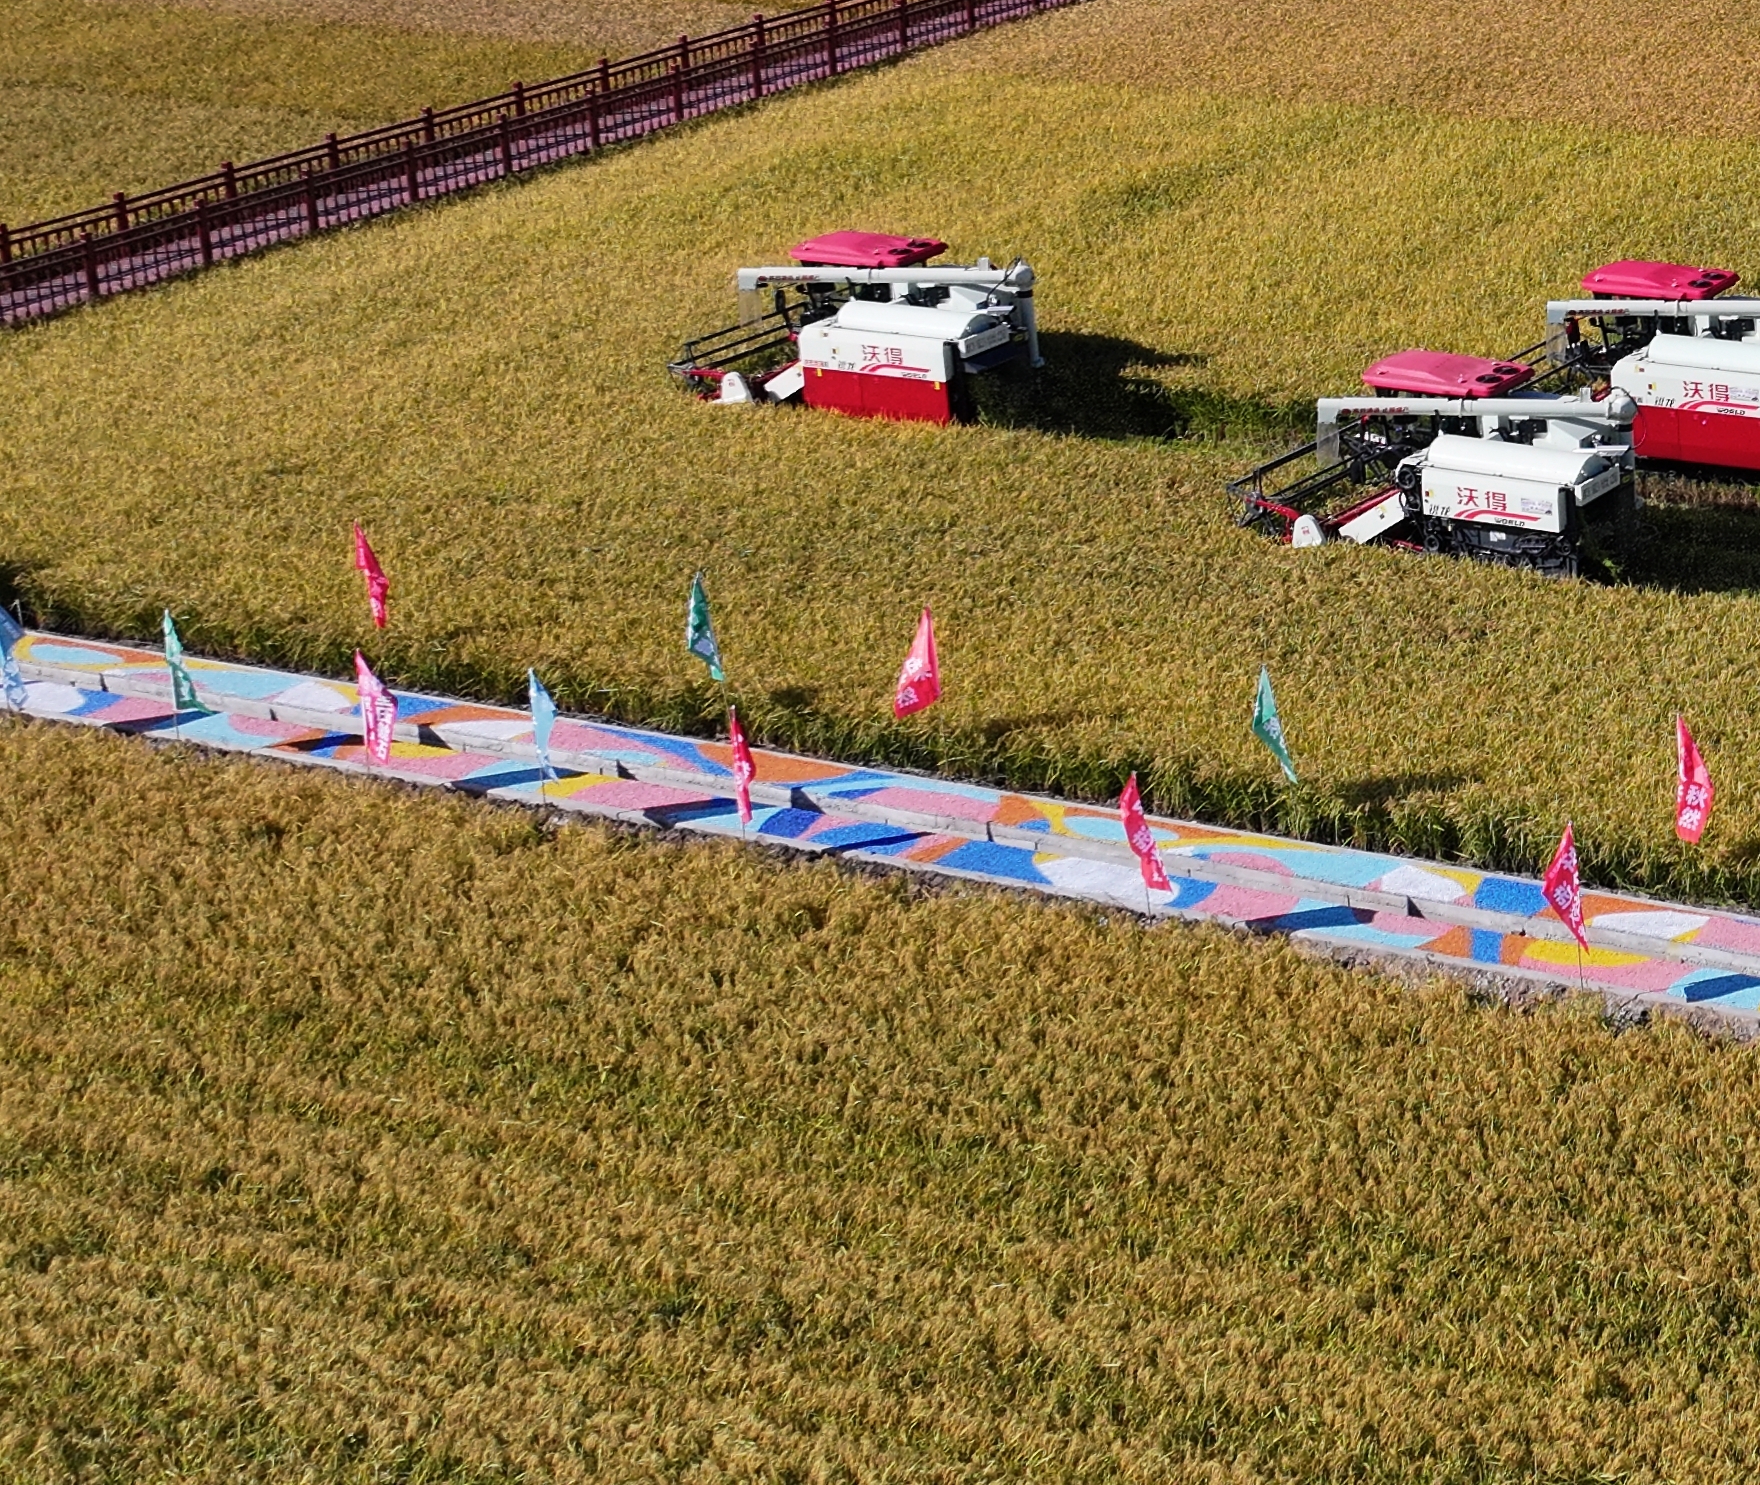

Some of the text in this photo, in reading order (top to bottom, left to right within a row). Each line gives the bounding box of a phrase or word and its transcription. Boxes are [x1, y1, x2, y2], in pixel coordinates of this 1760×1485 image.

[862, 344, 903, 365] 沃得
[1683, 380, 1730, 402] 沃得
[1456, 485, 1508, 512] 沃得
[1494, 516, 1526, 527] WORLD
